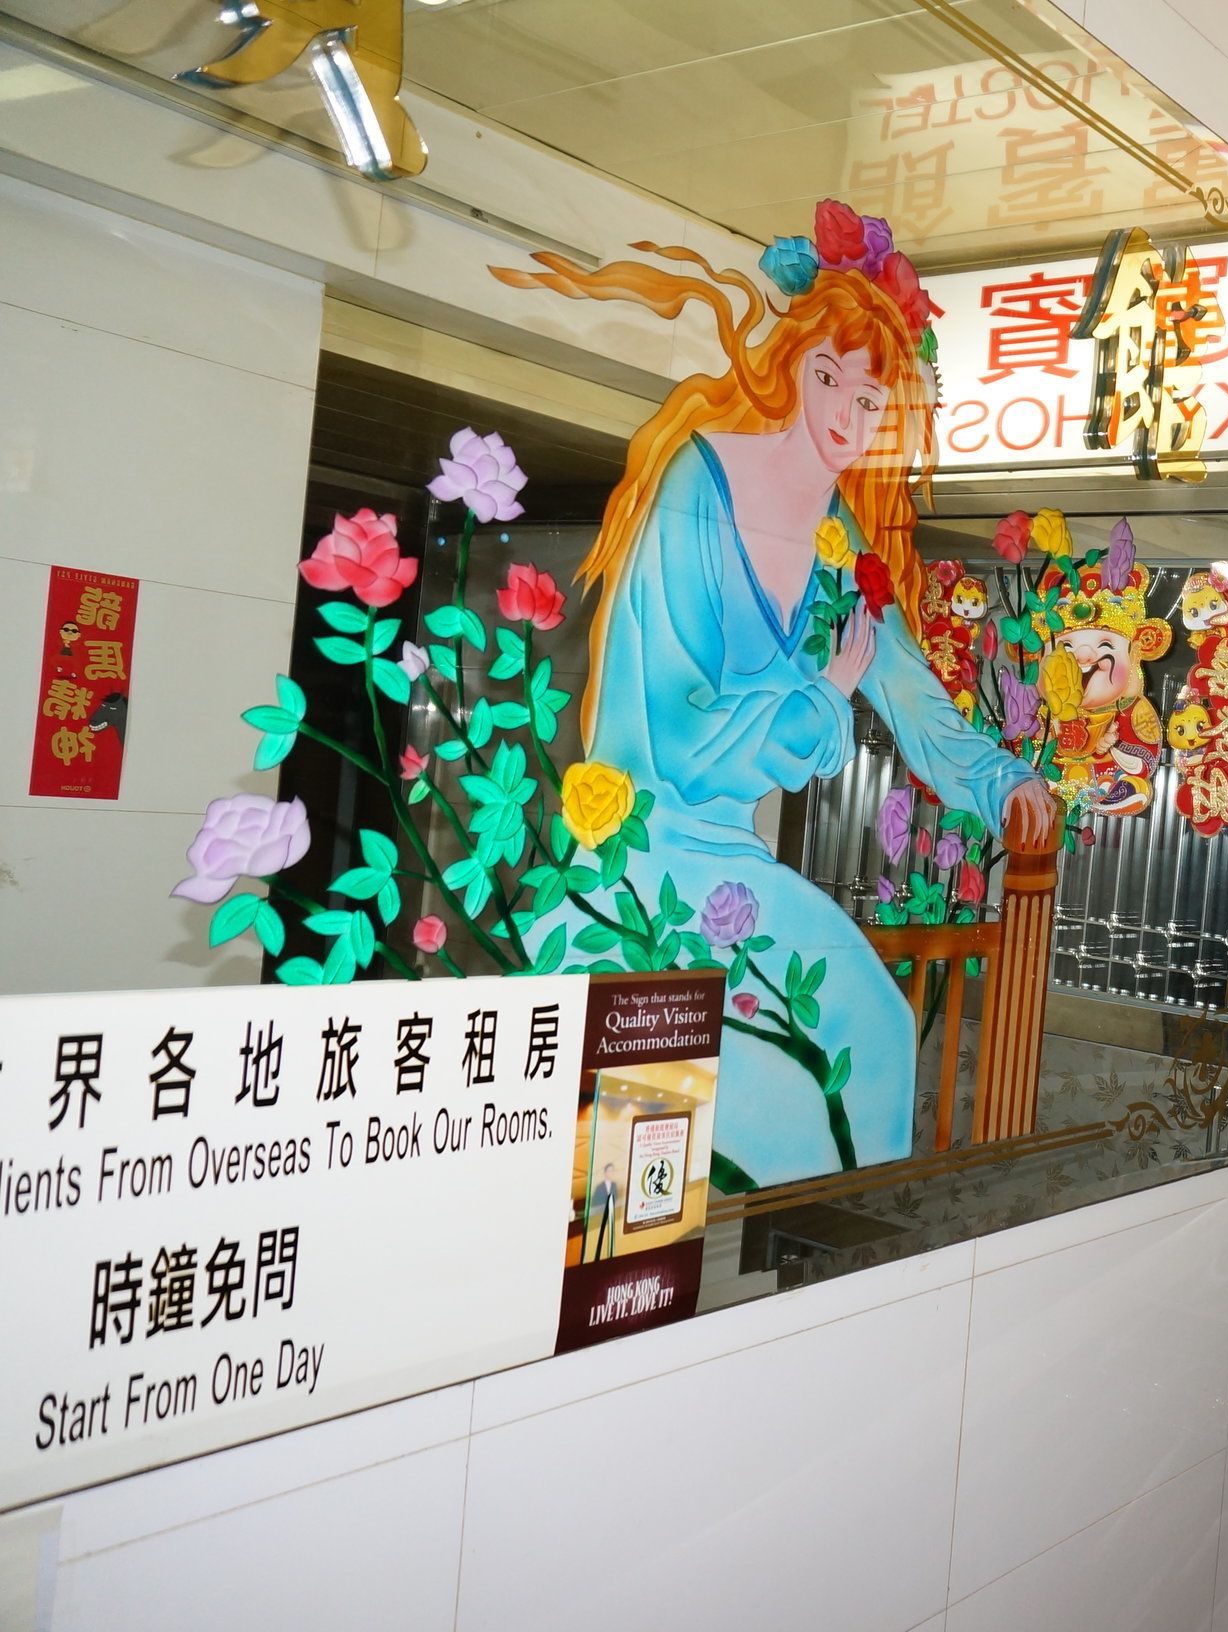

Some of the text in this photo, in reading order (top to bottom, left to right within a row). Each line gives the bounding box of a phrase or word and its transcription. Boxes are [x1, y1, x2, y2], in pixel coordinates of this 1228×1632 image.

[612, 990, 706, 1007] The Sign that stands for
[605, 1007, 708, 1033] Quality Visitor
[596, 1029, 711, 1055] Accommodation
[0, 1003, 560, 1131] 界各地旅客租房
[97, 1146, 174, 1203] From
[188, 1136, 311, 1189] Overseas
[326, 1120, 353, 1170] To
[365, 1111, 423, 1164] Book
[433, 1107, 472, 1155] Our
[480, 1102, 553, 1149] Rooms.
[89, 1226, 300, 1350] 時鐘免問
[589, 1301, 614, 1326] LIVE
[630, 1291, 657, 1316] LOVE
[658, 1286, 674, 1308] IT!
[607, 1275, 661, 1305] HONG KONG
[35, 1339, 325, 1450] Start From One Day
